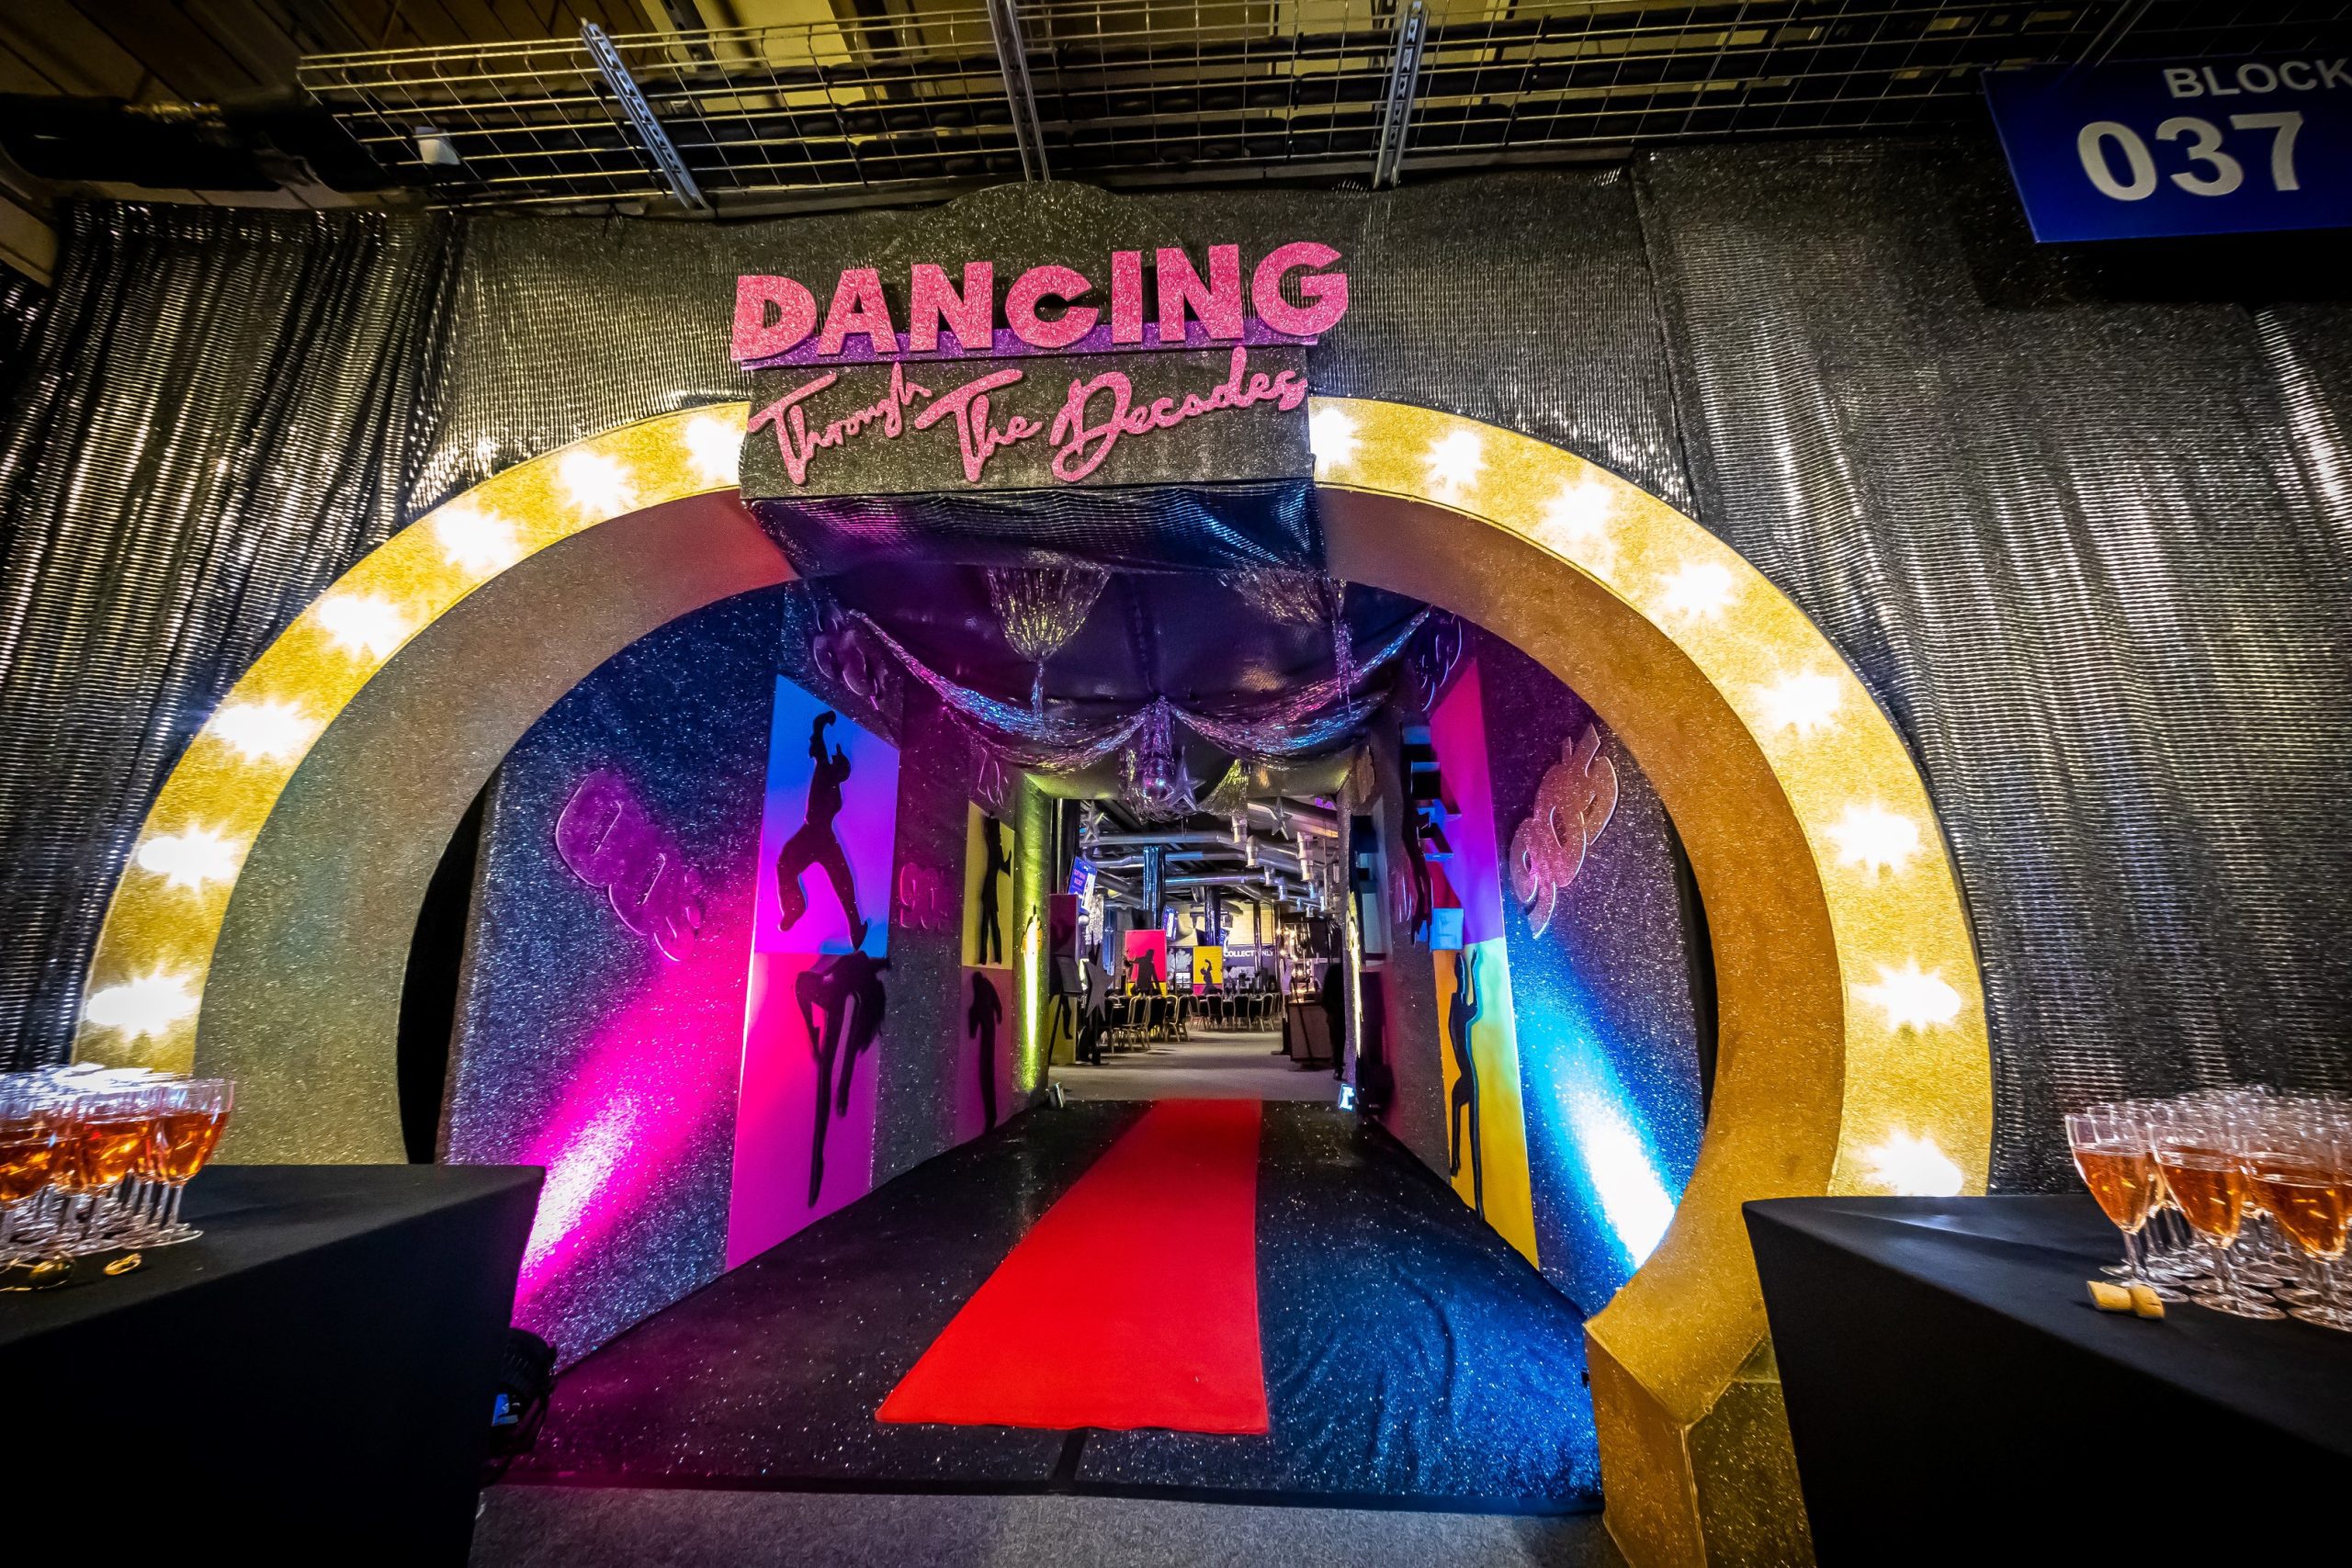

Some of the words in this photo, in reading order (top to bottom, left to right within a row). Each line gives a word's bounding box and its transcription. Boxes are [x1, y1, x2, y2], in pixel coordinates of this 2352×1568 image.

[2162, 57, 2352, 99] BLOCK
[2076, 110, 2304, 202] 037
[730, 241, 1349, 361] DANCING
[748, 361, 933, 487] Through
[914, 368, 1043, 484] The
[1049, 345, 1308, 485] Decades
